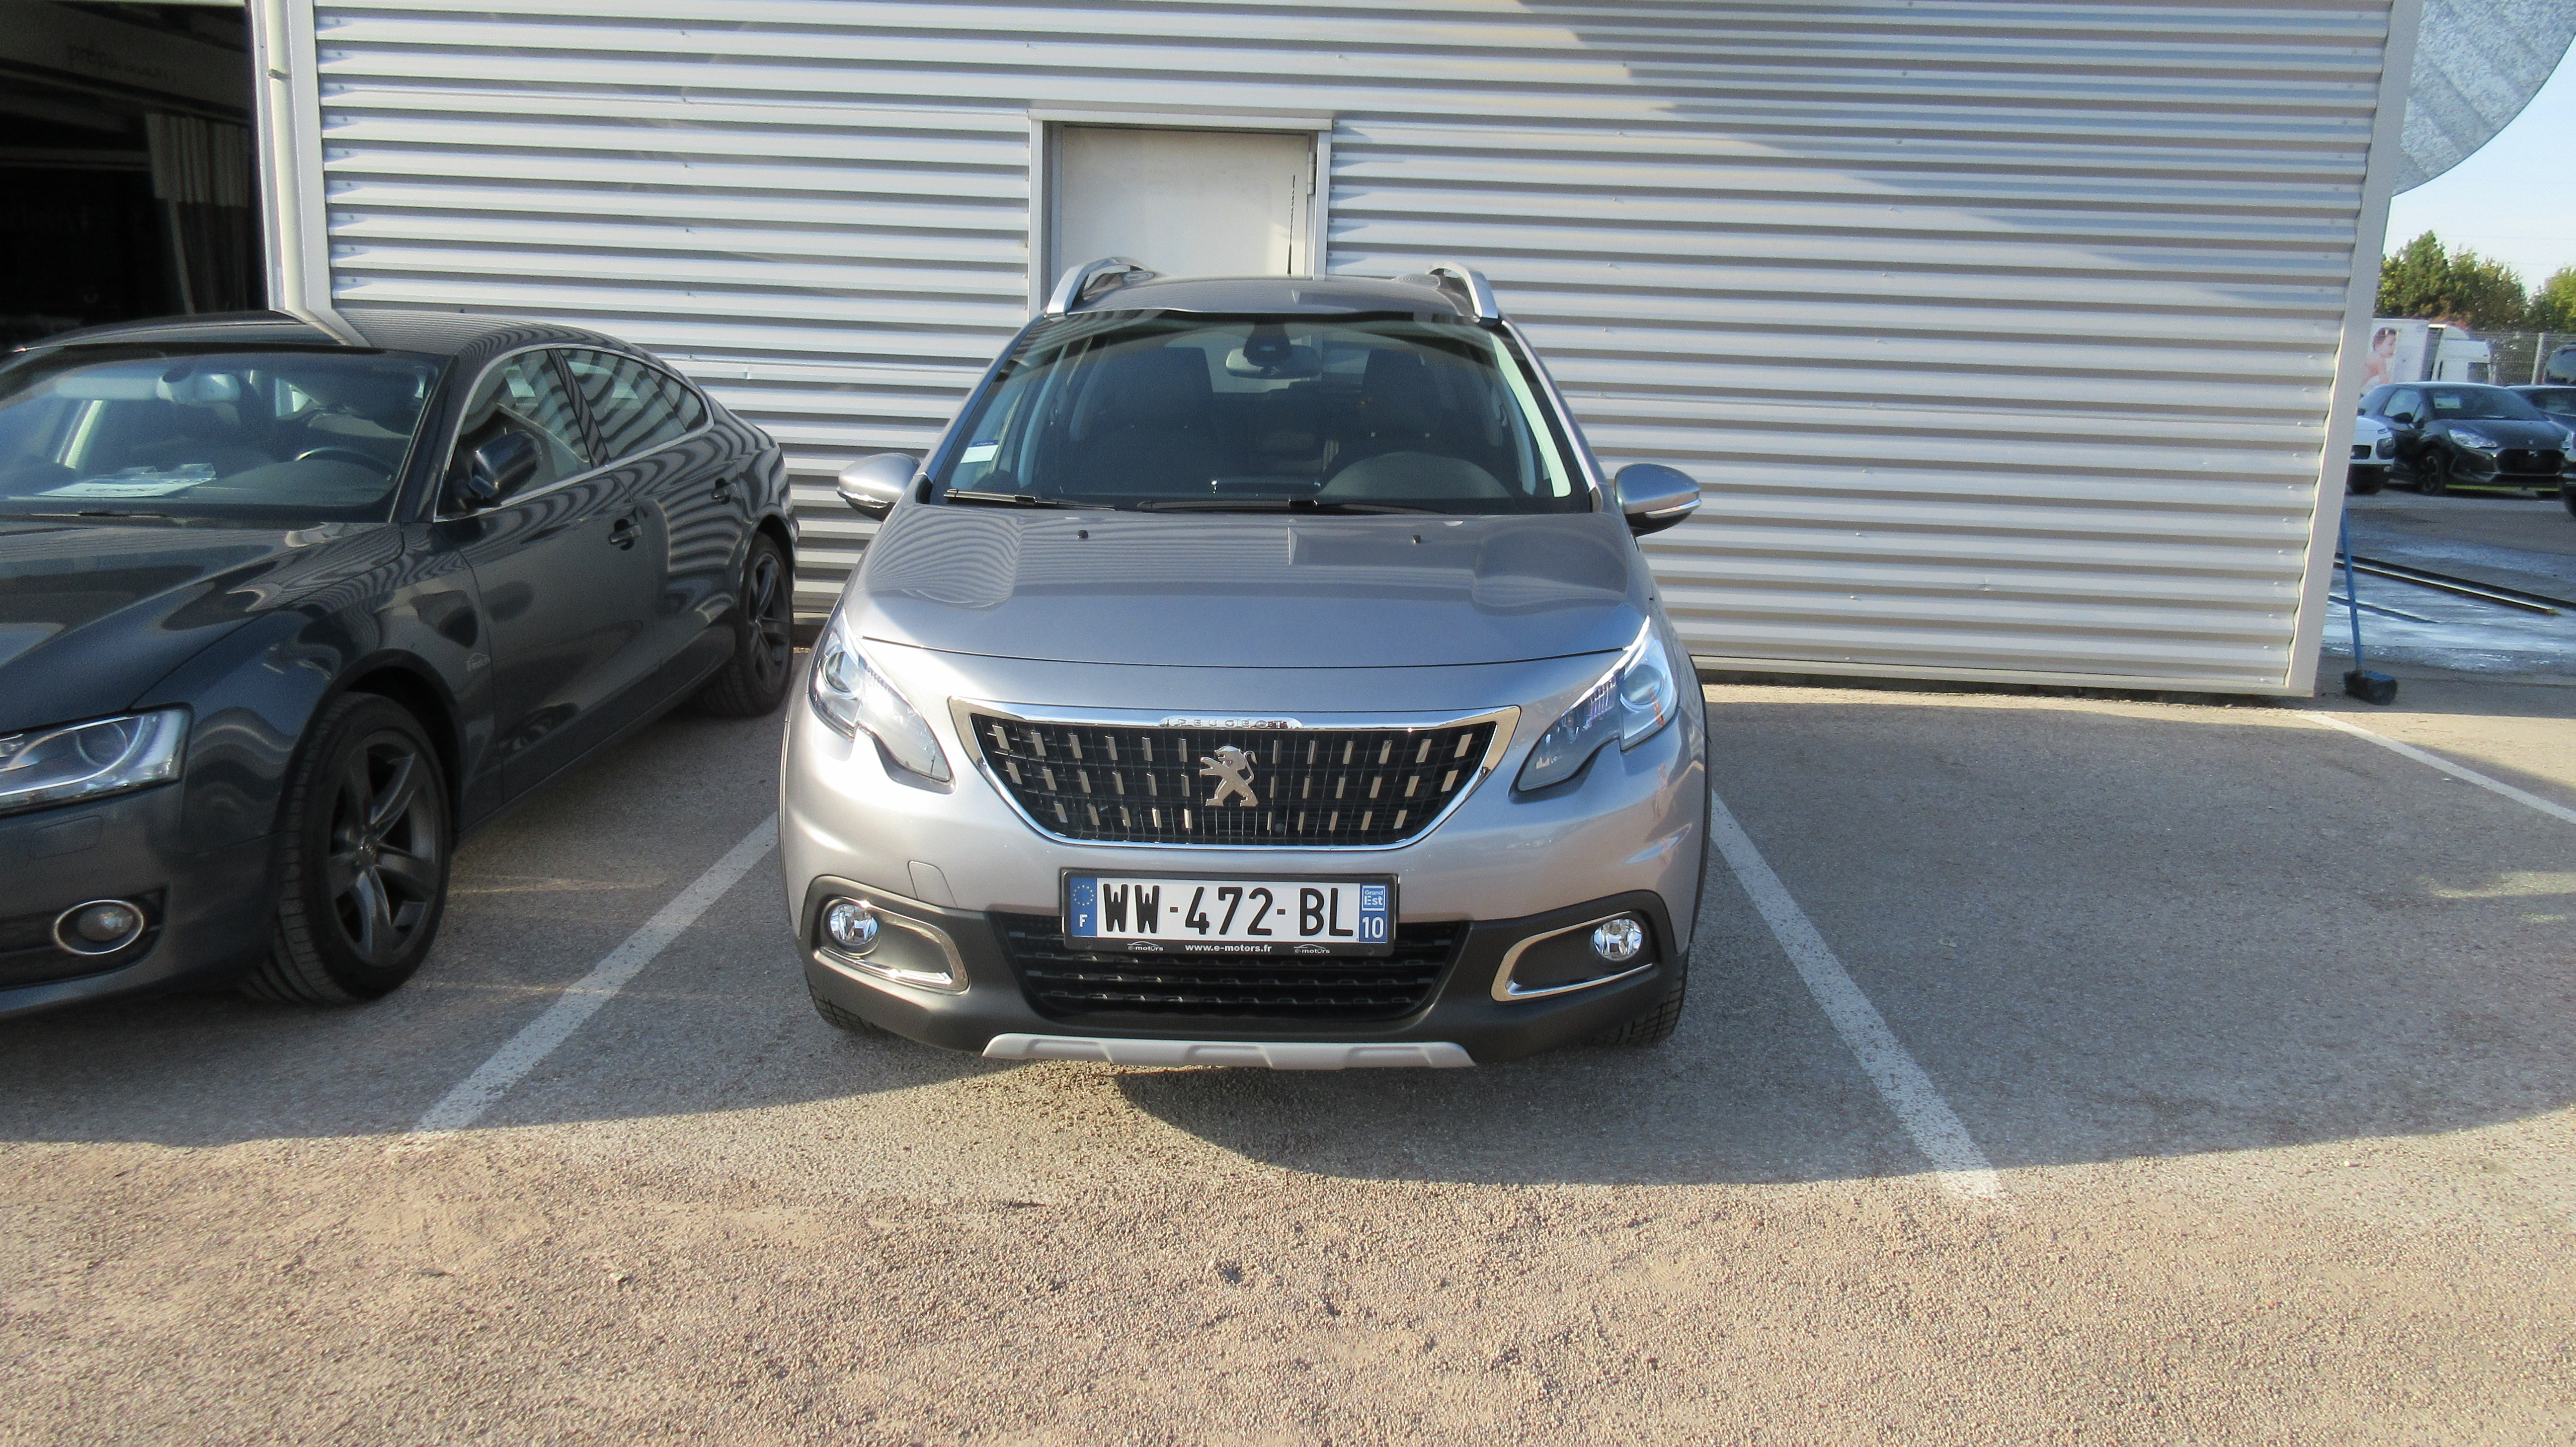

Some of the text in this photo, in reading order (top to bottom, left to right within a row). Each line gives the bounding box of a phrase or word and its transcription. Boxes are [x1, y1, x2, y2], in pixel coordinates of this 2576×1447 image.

[1178, 719, 1288, 729] PEUGEOT
[1364, 895, 1383, 905] Est
[1103, 884, 1353, 936] WW-472-BL
[1079, 914, 1088, 927] F
[1362, 917, 1384, 938] 10
[1185, 944, 1272, 953] www.e-motors.fr
